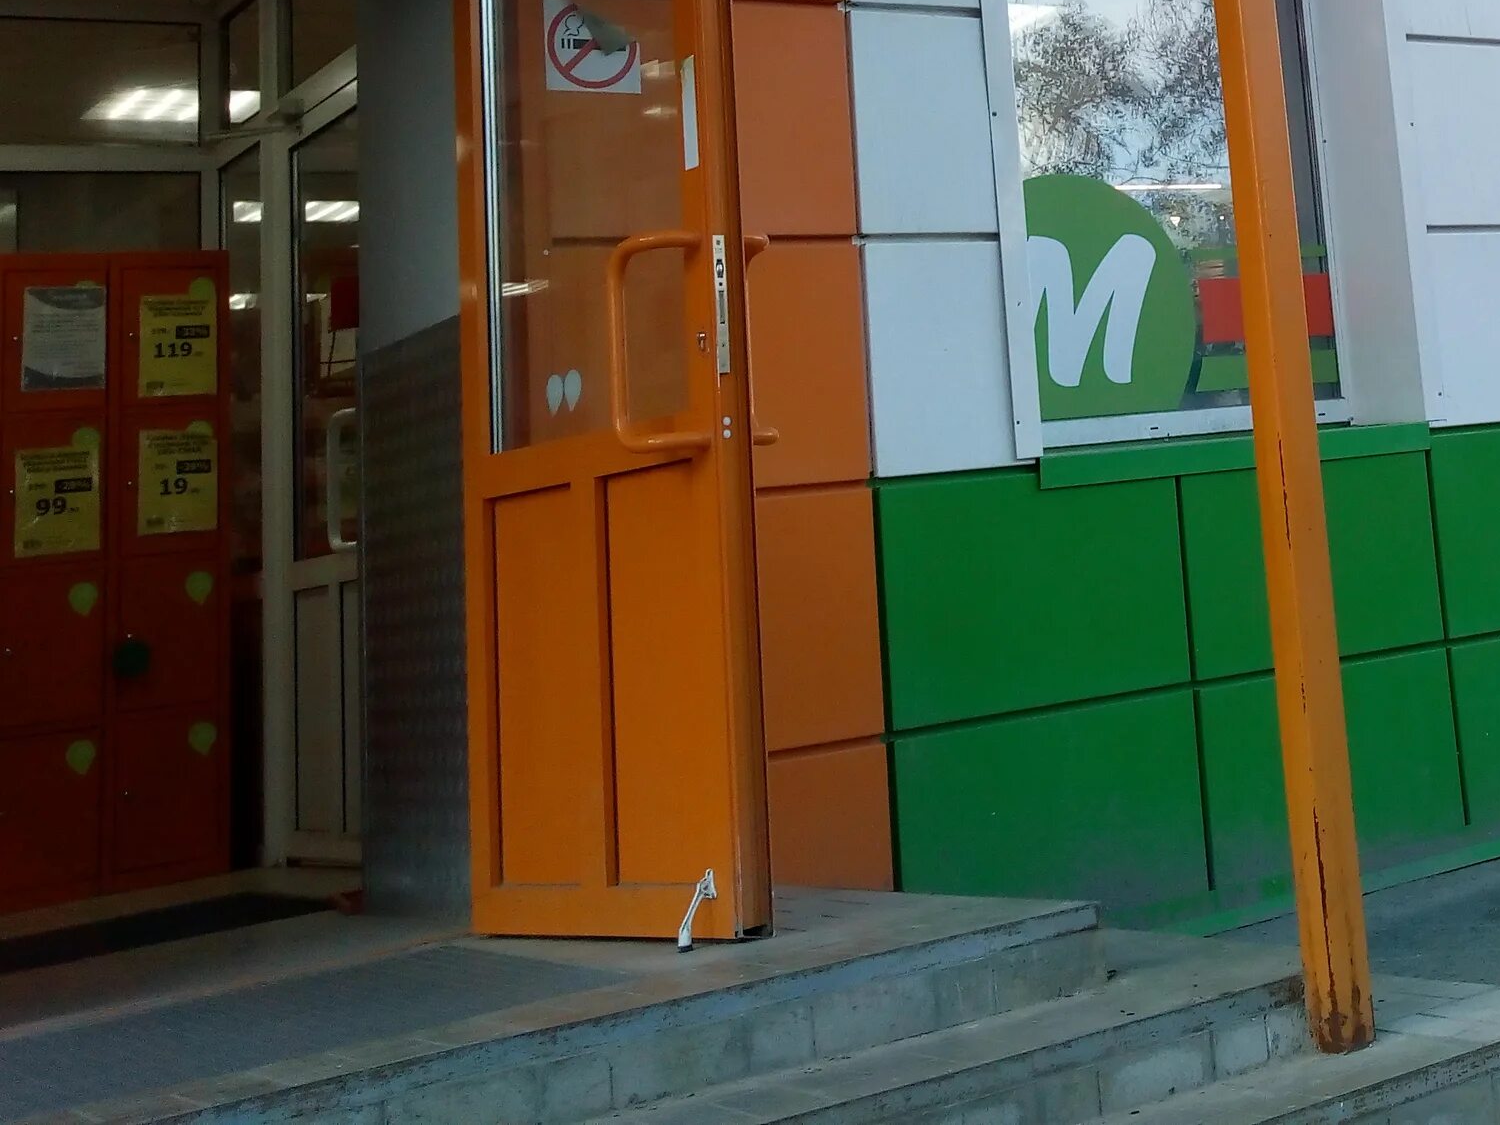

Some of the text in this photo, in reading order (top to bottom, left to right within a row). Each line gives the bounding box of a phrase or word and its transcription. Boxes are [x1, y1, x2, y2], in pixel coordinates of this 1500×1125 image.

[153, 341, 193, 359] 119
[159, 477, 189, 496] 19
[35, 496, 68, 517] 99
